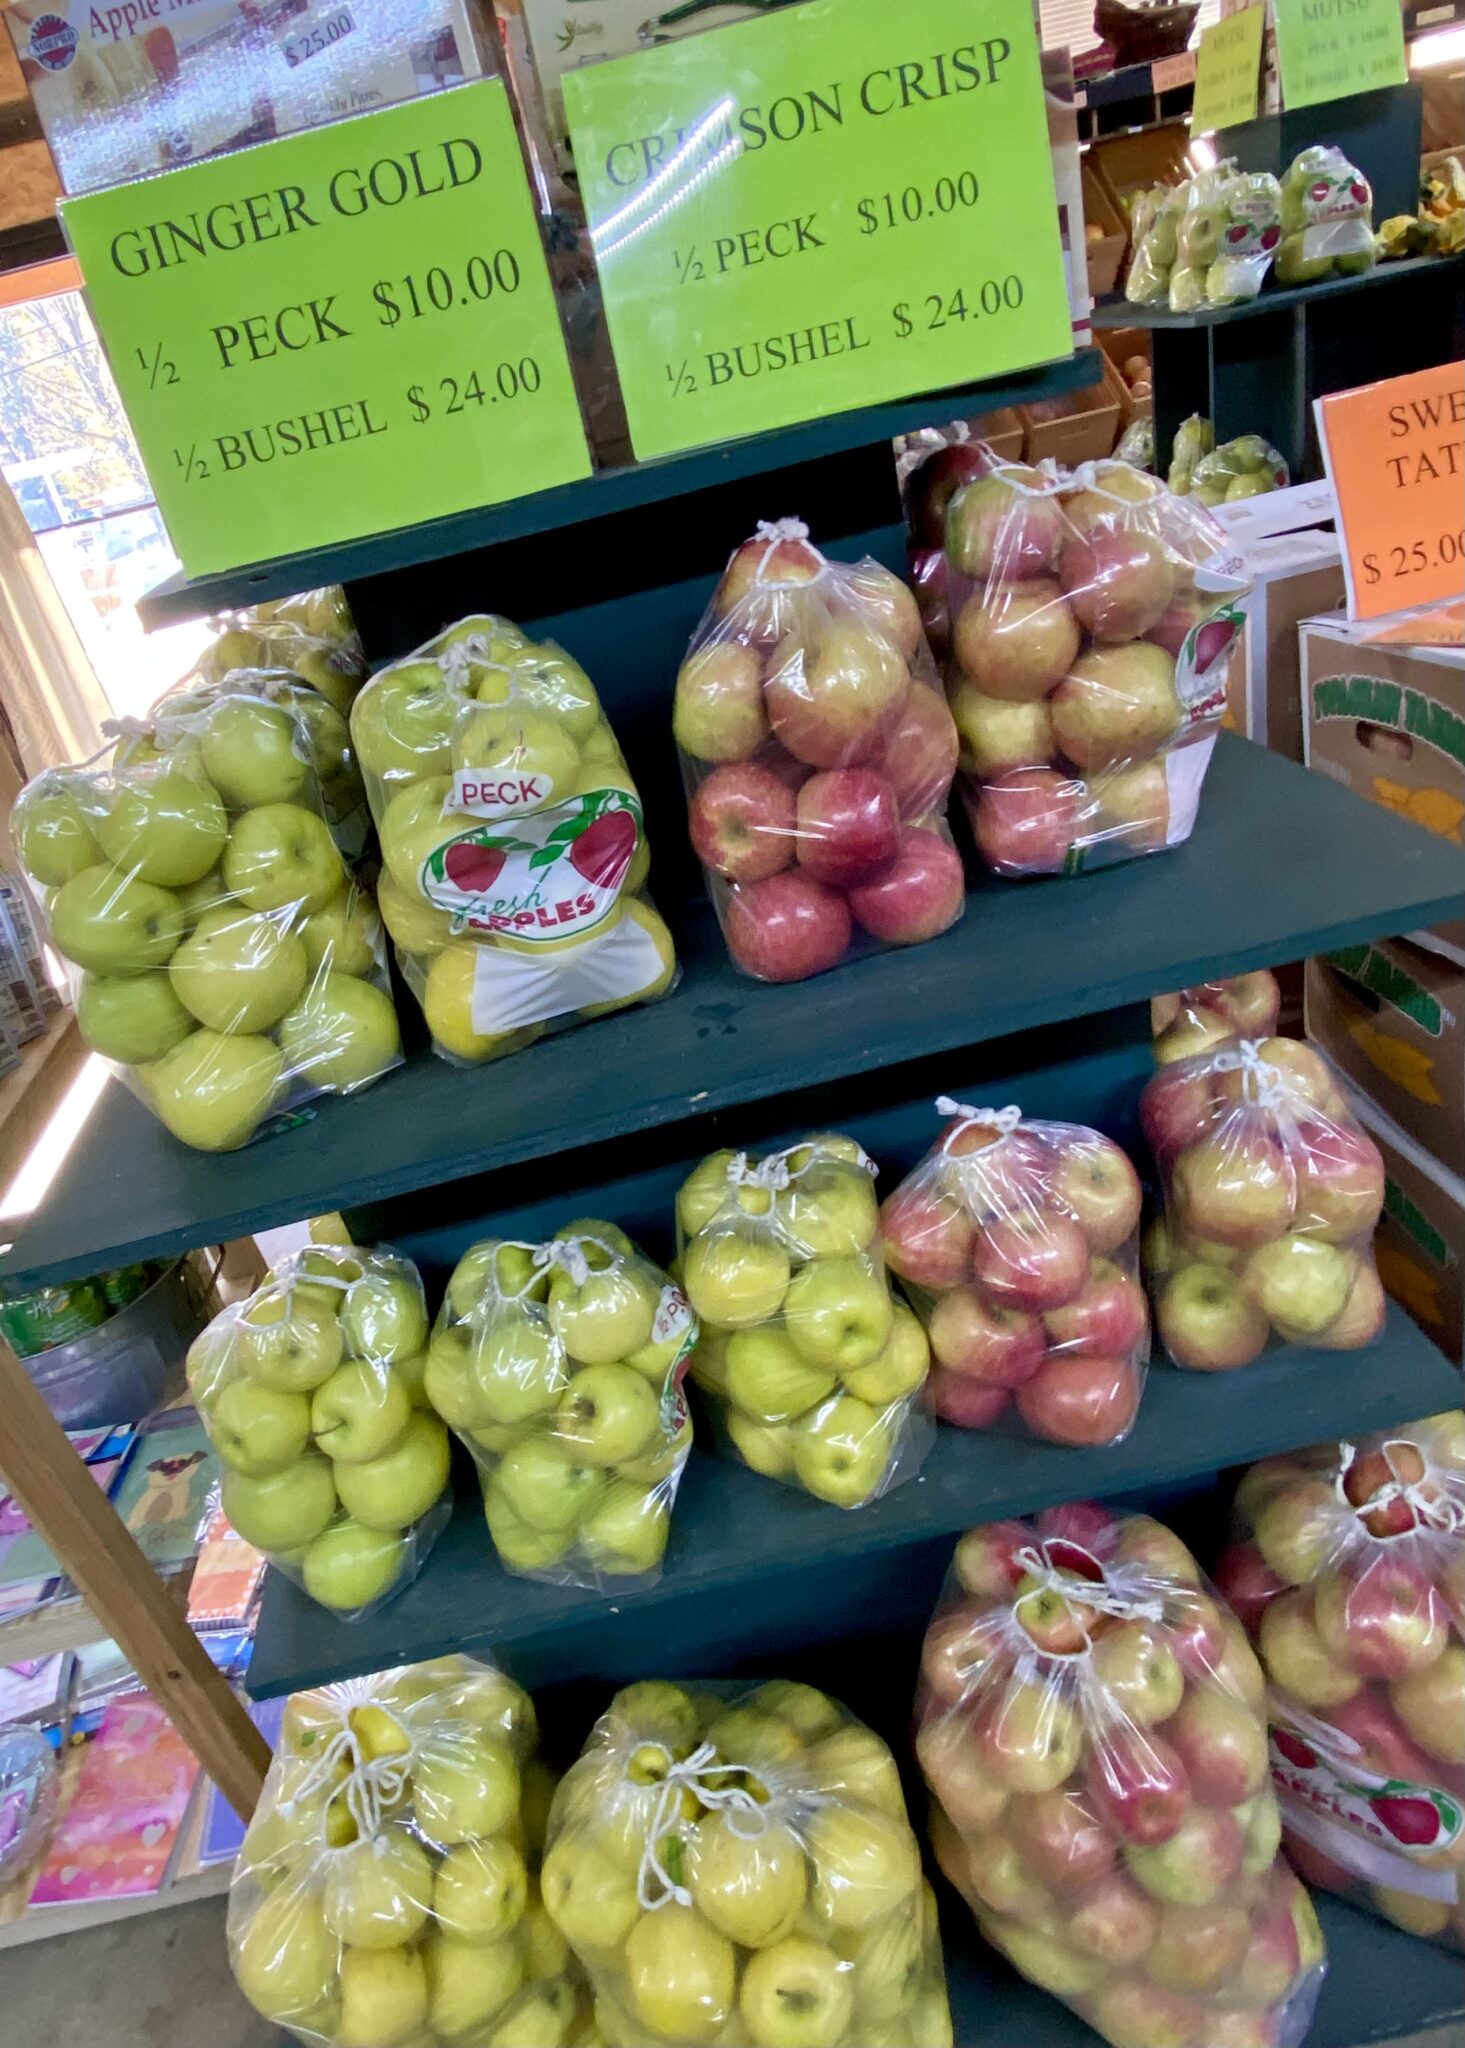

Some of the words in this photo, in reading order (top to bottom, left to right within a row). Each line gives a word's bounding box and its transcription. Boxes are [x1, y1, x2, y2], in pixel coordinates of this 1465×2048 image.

[90, 0, 160, 41] Apple
[860, 38, 1010, 116] CRISP
[110, 185, 321, 278] GINGER
[329, 138, 483, 217] GOLD
[713, 214, 826, 273] PECK
[857, 171, 979, 235] $10.00
[210, 297, 352, 369] PECK
[372, 249, 520, 327] $10.00
[706, 317, 871, 386] BUSHEL
[215, 400, 387, 472] BUSHEL
[461, 777, 543, 807] PECK
